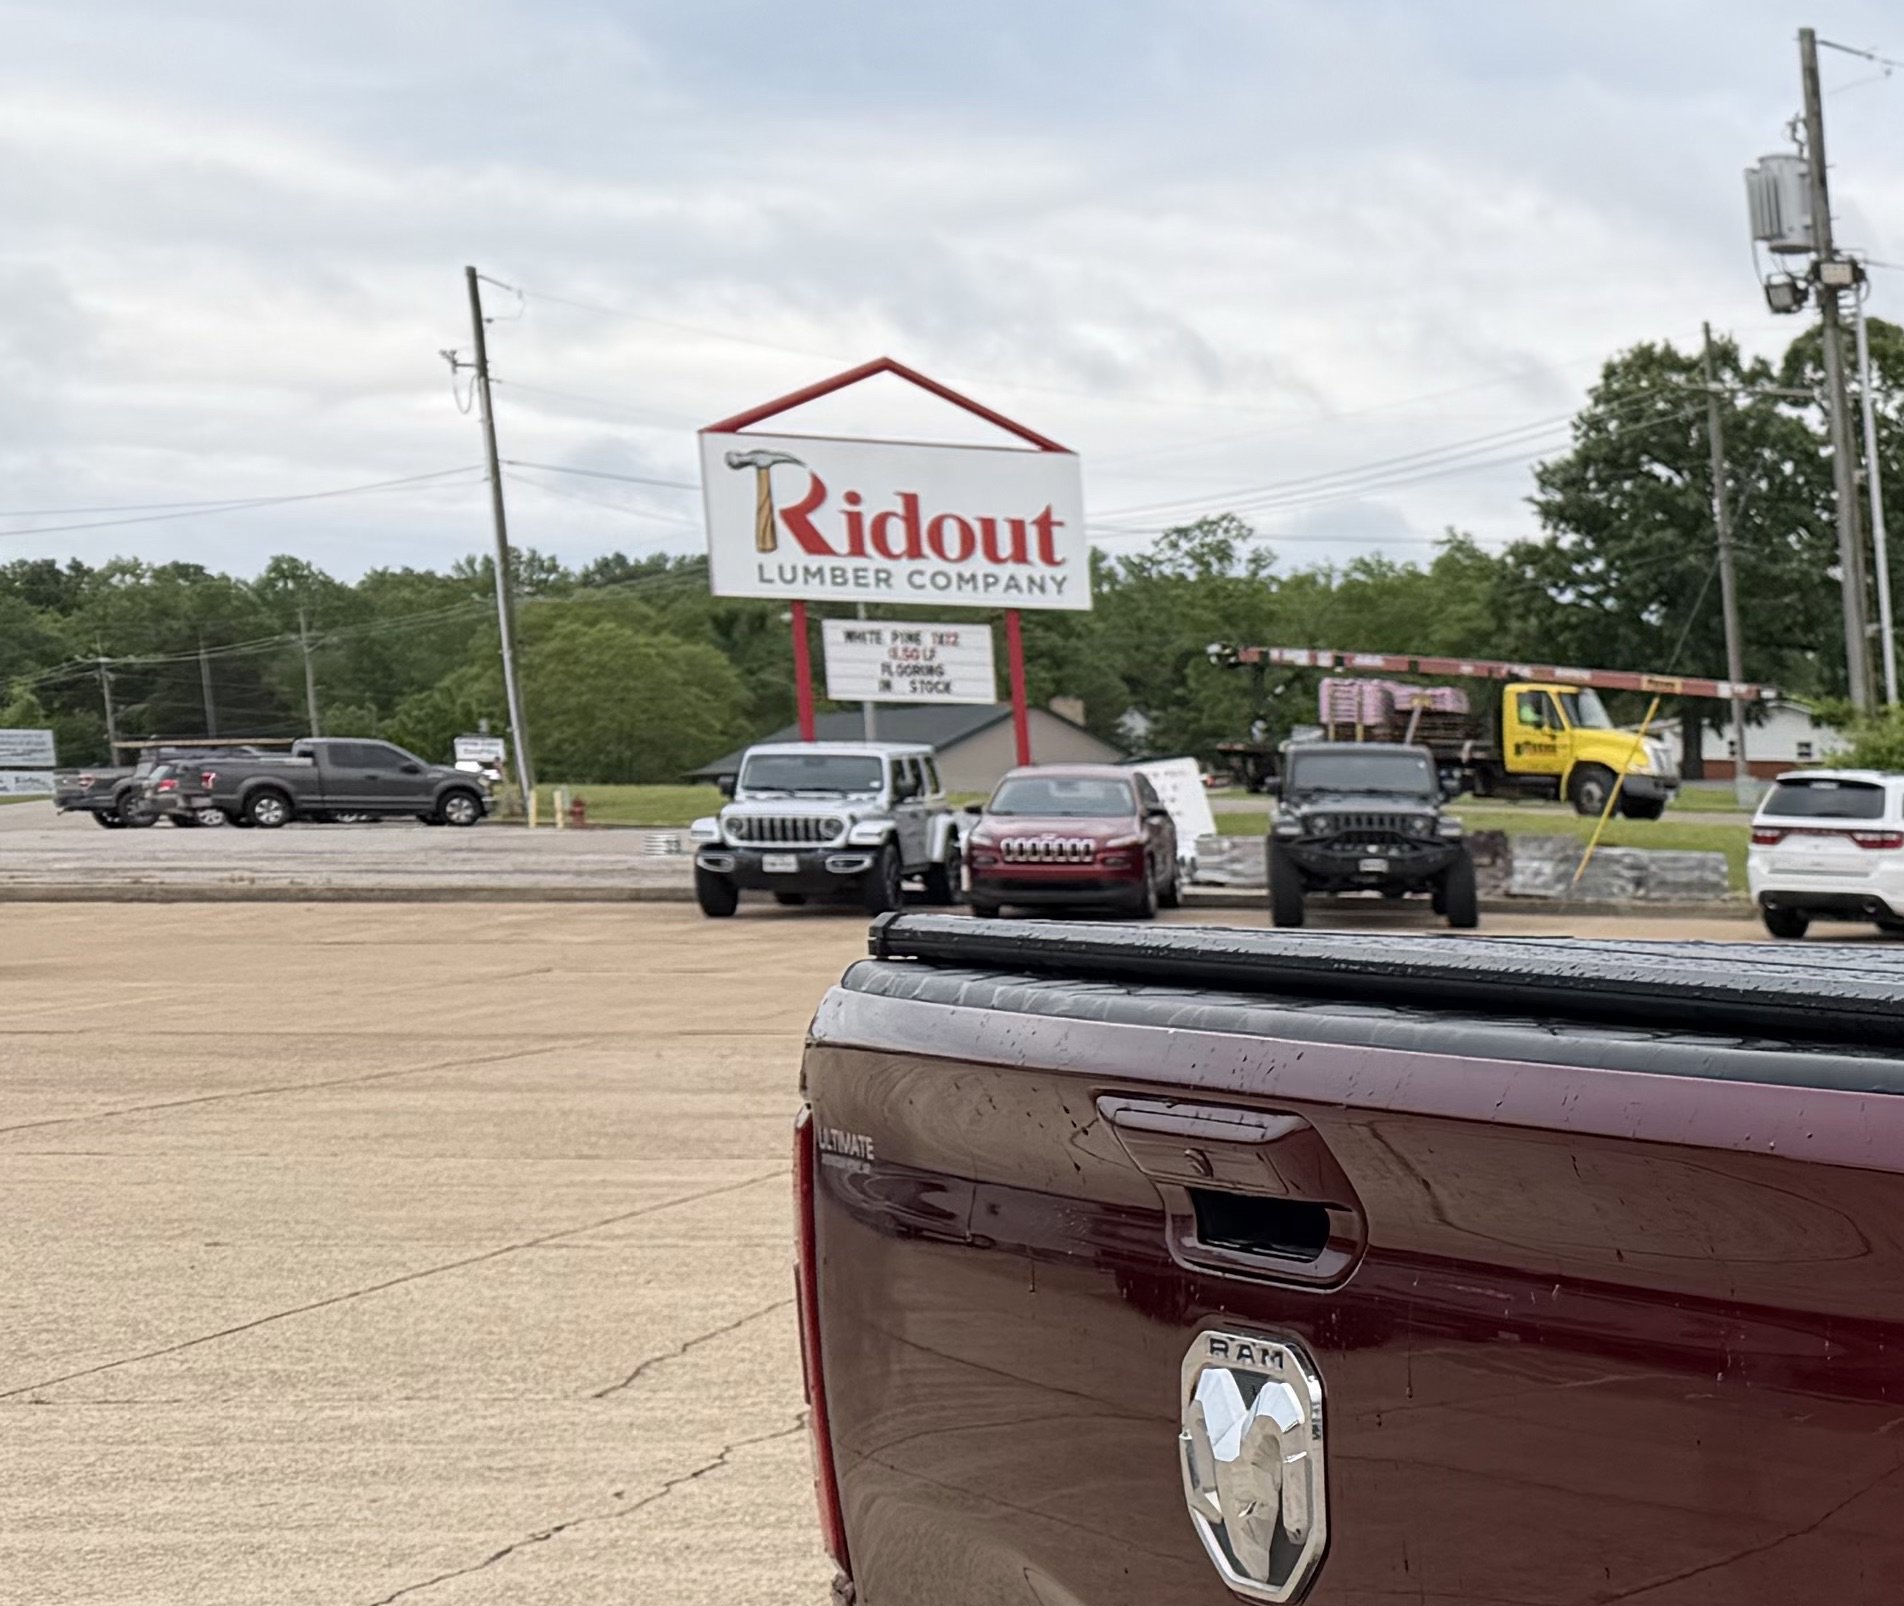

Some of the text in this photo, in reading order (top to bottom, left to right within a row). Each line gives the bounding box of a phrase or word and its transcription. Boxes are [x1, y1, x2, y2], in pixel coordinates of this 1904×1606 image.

[757, 450, 1067, 567] Ridout
[757, 563, 1068, 595] LUMBER COMPANY
[843, 630, 882, 645] WHITE
[891, 631, 921, 646] PINE
[909, 680, 952, 695] STOCK
[818, 1126, 875, 1161] ULTIMATE
[1209, 1337, 1284, 1369] RAM
